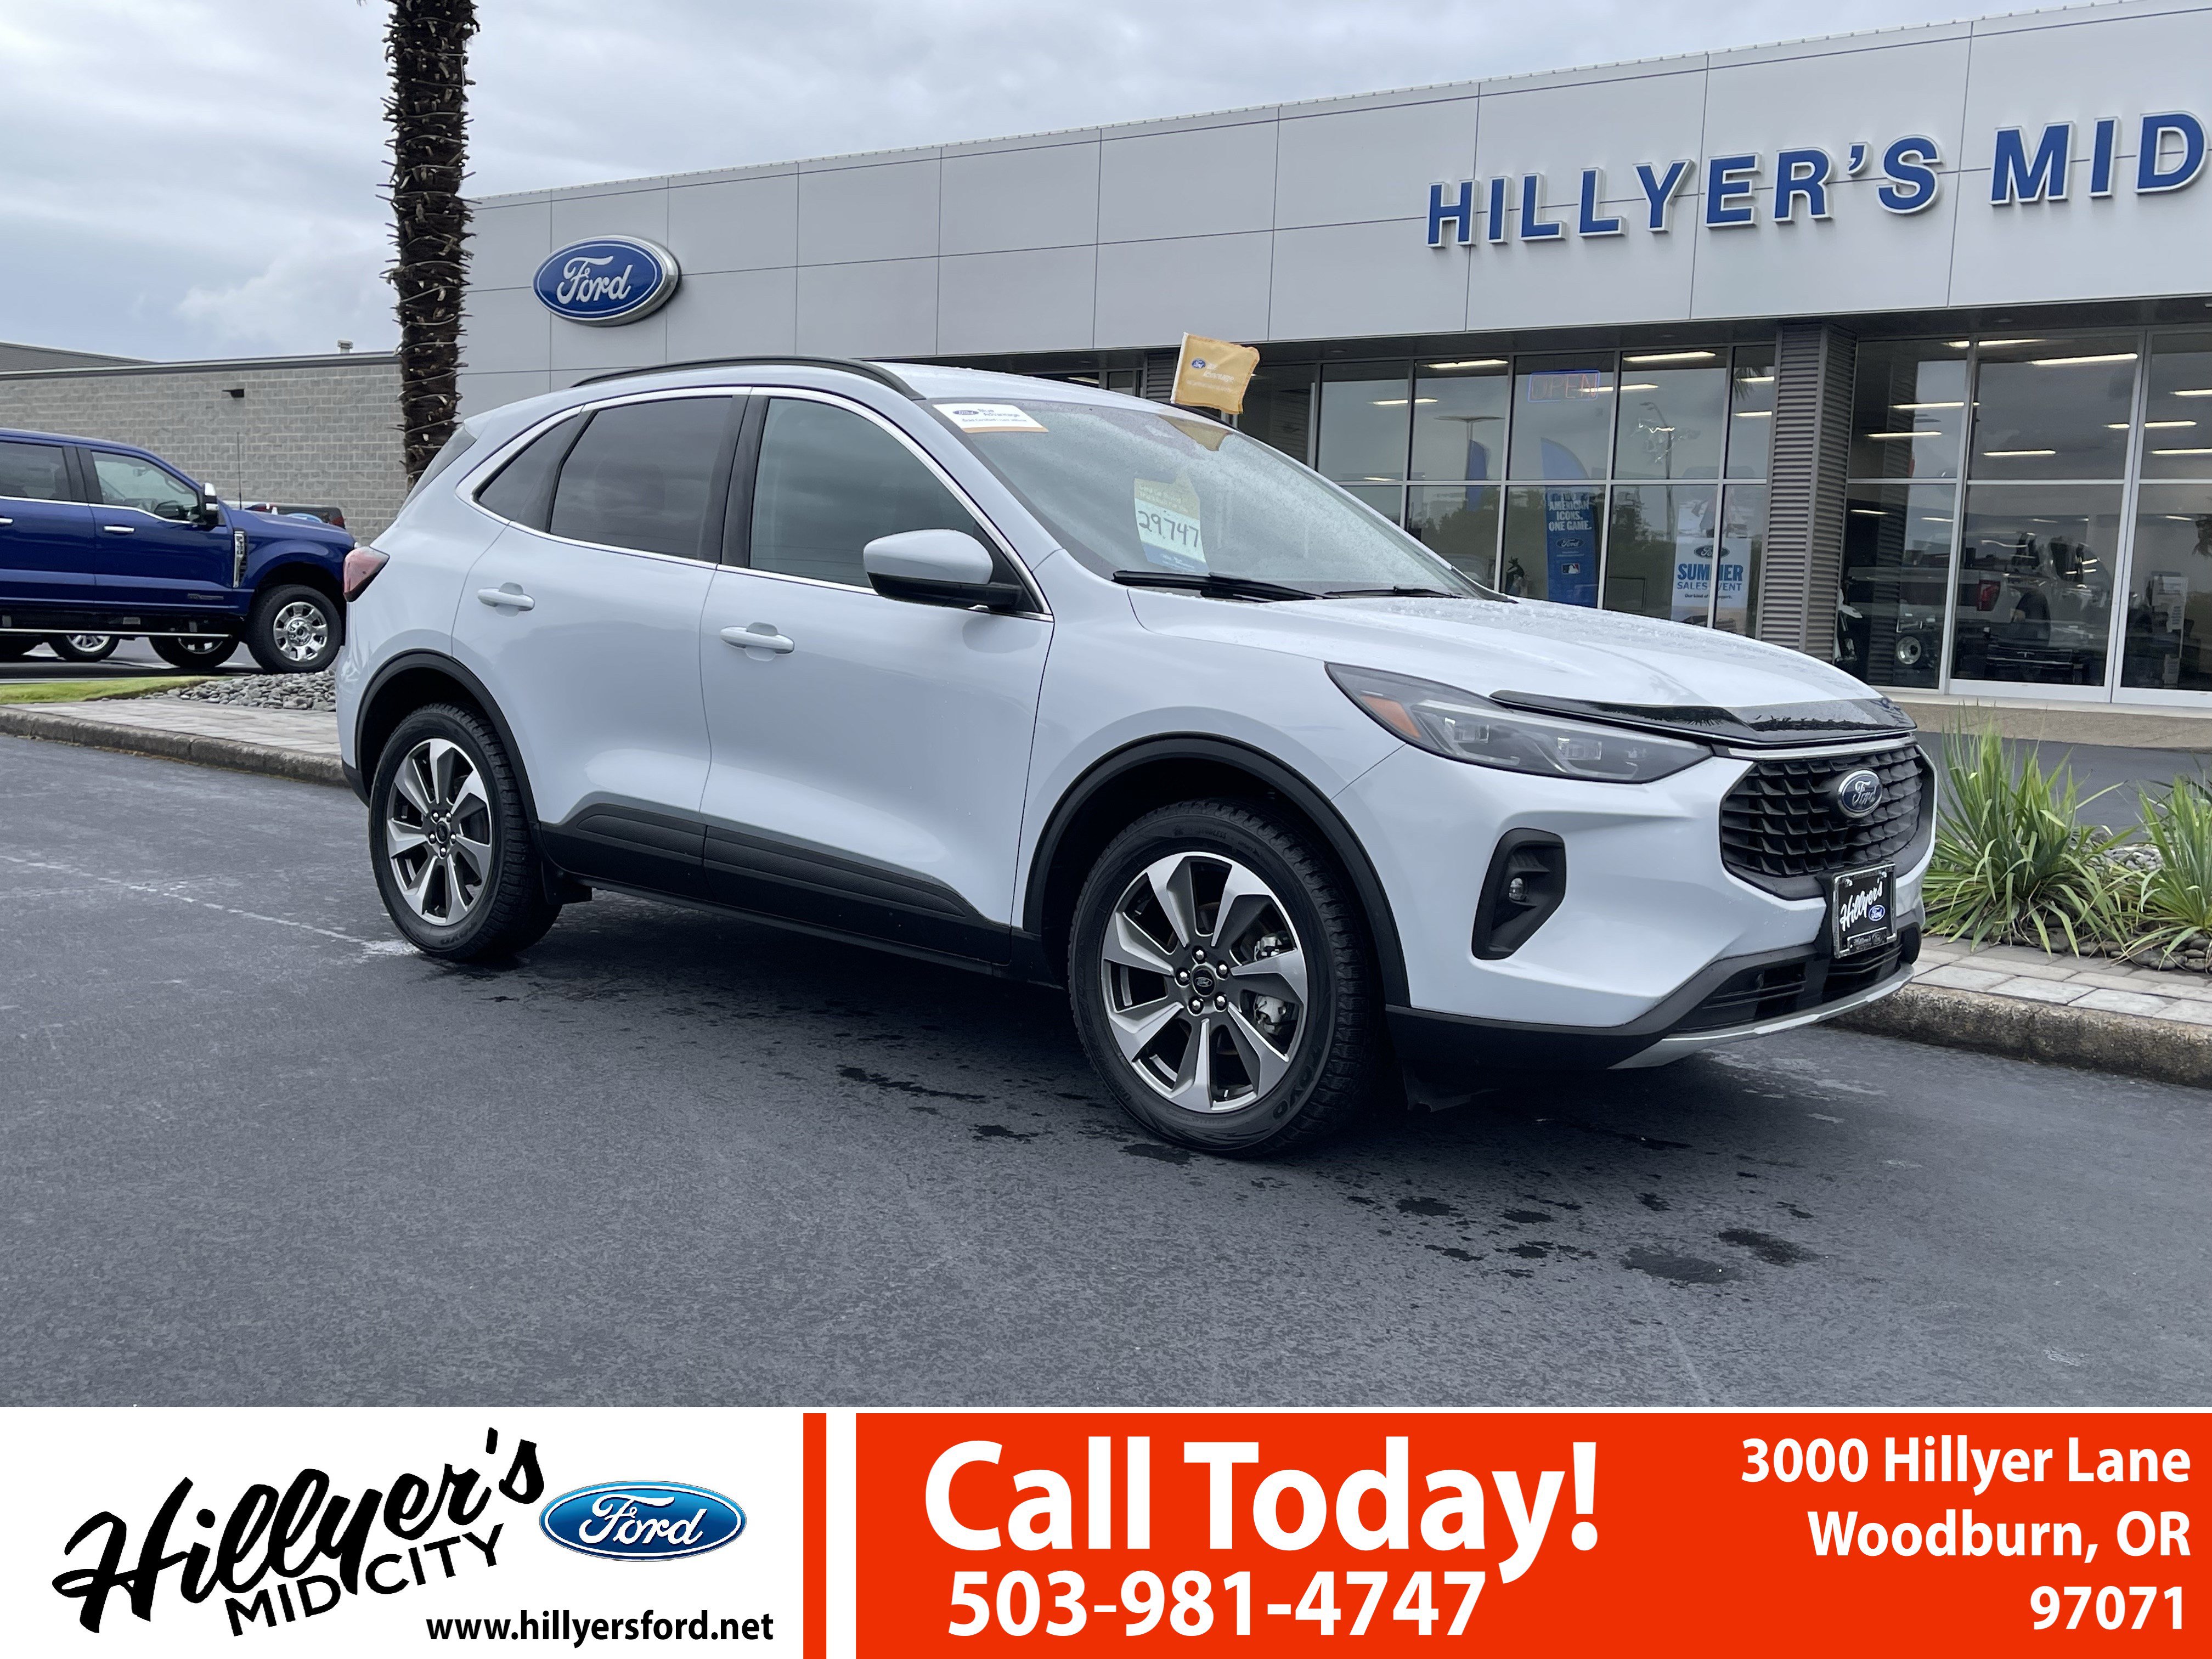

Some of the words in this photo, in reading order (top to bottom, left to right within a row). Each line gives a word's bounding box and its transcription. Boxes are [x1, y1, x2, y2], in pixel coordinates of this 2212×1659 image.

[1426, 137, 1939, 246] HILLYER'S
[1989, 113, 2207, 203] MID
[556, 255, 634, 304] Ford
[1531, 373, 1598, 399] OPEN
[1549, 501, 1589, 511] AMERICAN
[1556, 511, 1583, 521] ICONS.
[1548, 521, 1565, 531] ONE
[1566, 521, 1592, 531] GAME.
[1561, 539, 1579, 547] Ford
[1677, 582, 1708, 590] SALES
[1852, 781, 1877, 806] Ford
